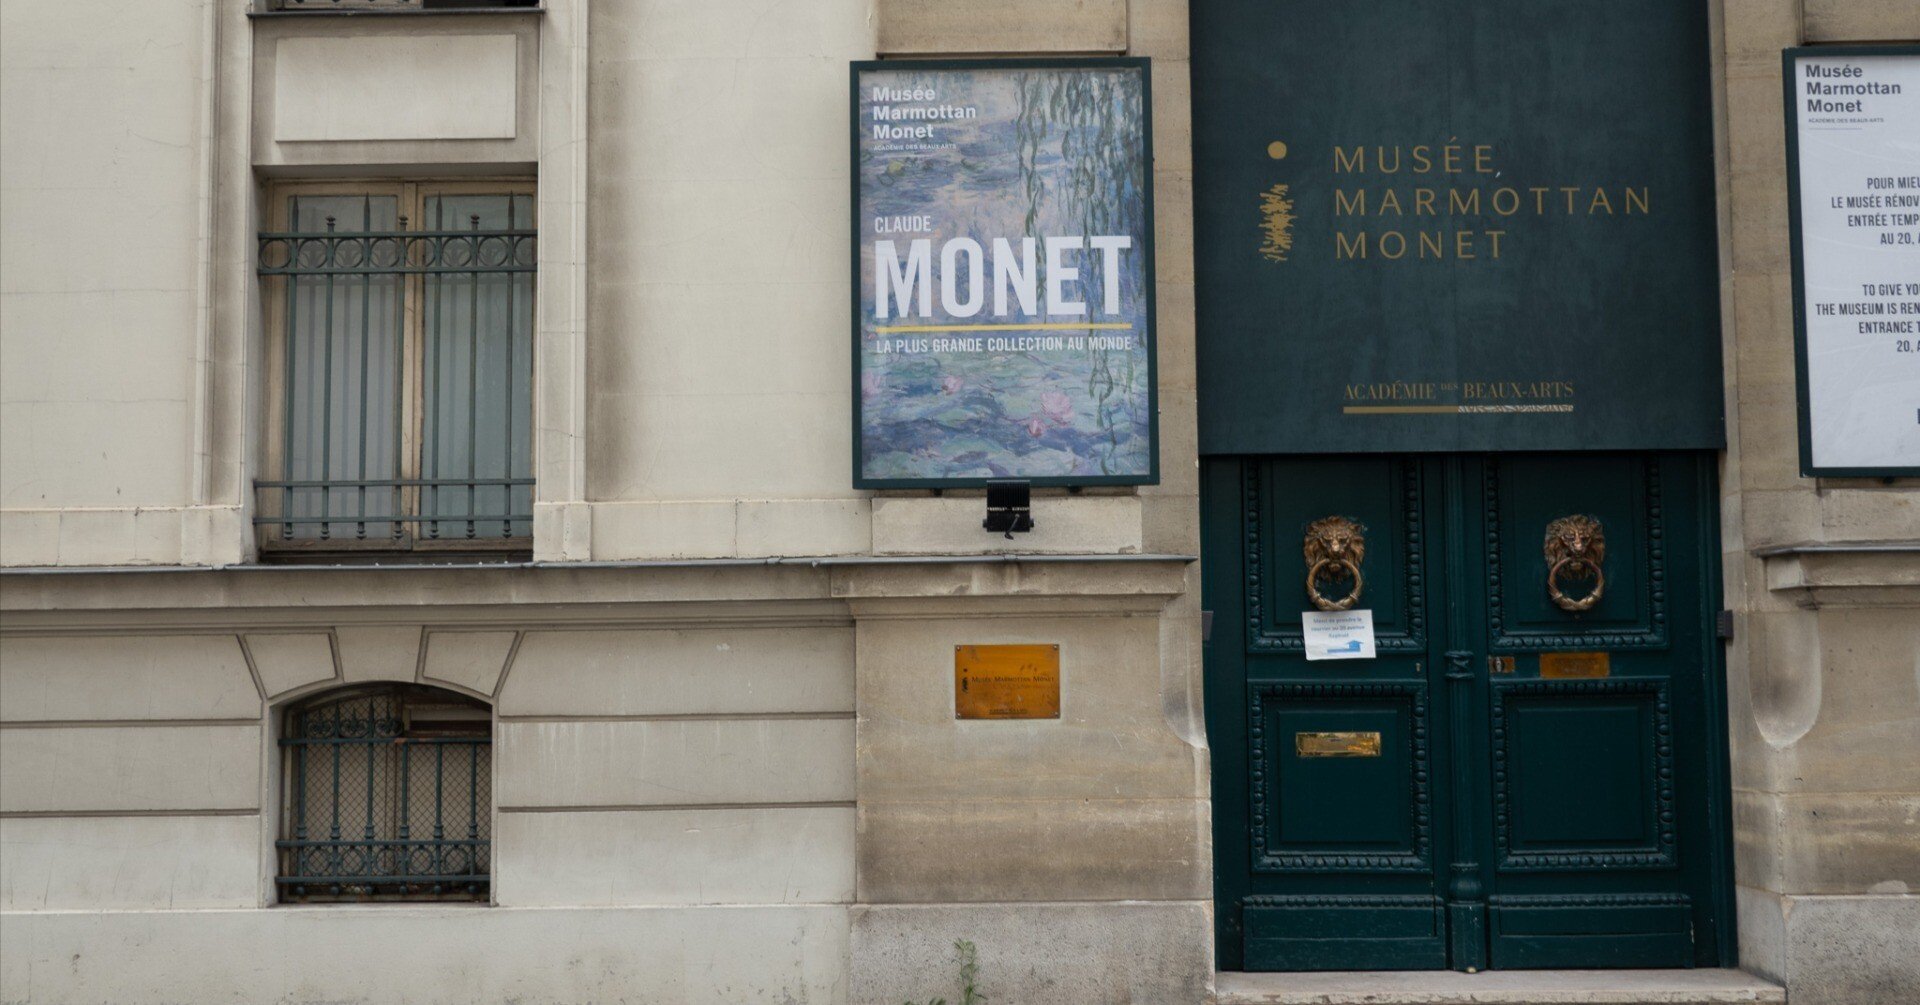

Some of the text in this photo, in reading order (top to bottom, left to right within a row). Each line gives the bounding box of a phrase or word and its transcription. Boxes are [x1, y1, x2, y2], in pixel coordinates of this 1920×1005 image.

[1805, 64, 1863, 78] Musée
[873, 86, 936, 101] Musée
[1806, 82, 1901, 95] Marmottan
[873, 105, 976, 120] Marmottan
[1807, 99, 1862, 113] Monet
[873, 124, 934, 139] Monet
[1333, 136, 1493, 173] MUSÉE
[1867, 177, 1894, 189] POUR
[1334, 187, 1649, 216] MARMOTTAN
[1831, 193, 1919, 209] LE MUSÉE RÉNOV
[874, 215, 932, 233] CLAUDE
[1848, 212, 1888, 227] ENTRÉE
[1336, 230, 1506, 260] MONET
[1880, 232, 1894, 245] AU
[875, 235, 1132, 319] MONET
[1862, 283, 1920, 296] TO GIVE YO
[1815, 303, 1836, 315] THE
[1839, 303, 1884, 315] MUSEUM
[1887, 302, 1898, 315] IS
[1859, 321, 1914, 334] ENTRANCE
[876, 335, 1132, 354] LA PLUS GRANDE COLLECTION AU MONDE
[1343, 379, 1574, 400] ACADÉMIE DES BEAUX-ARTS
